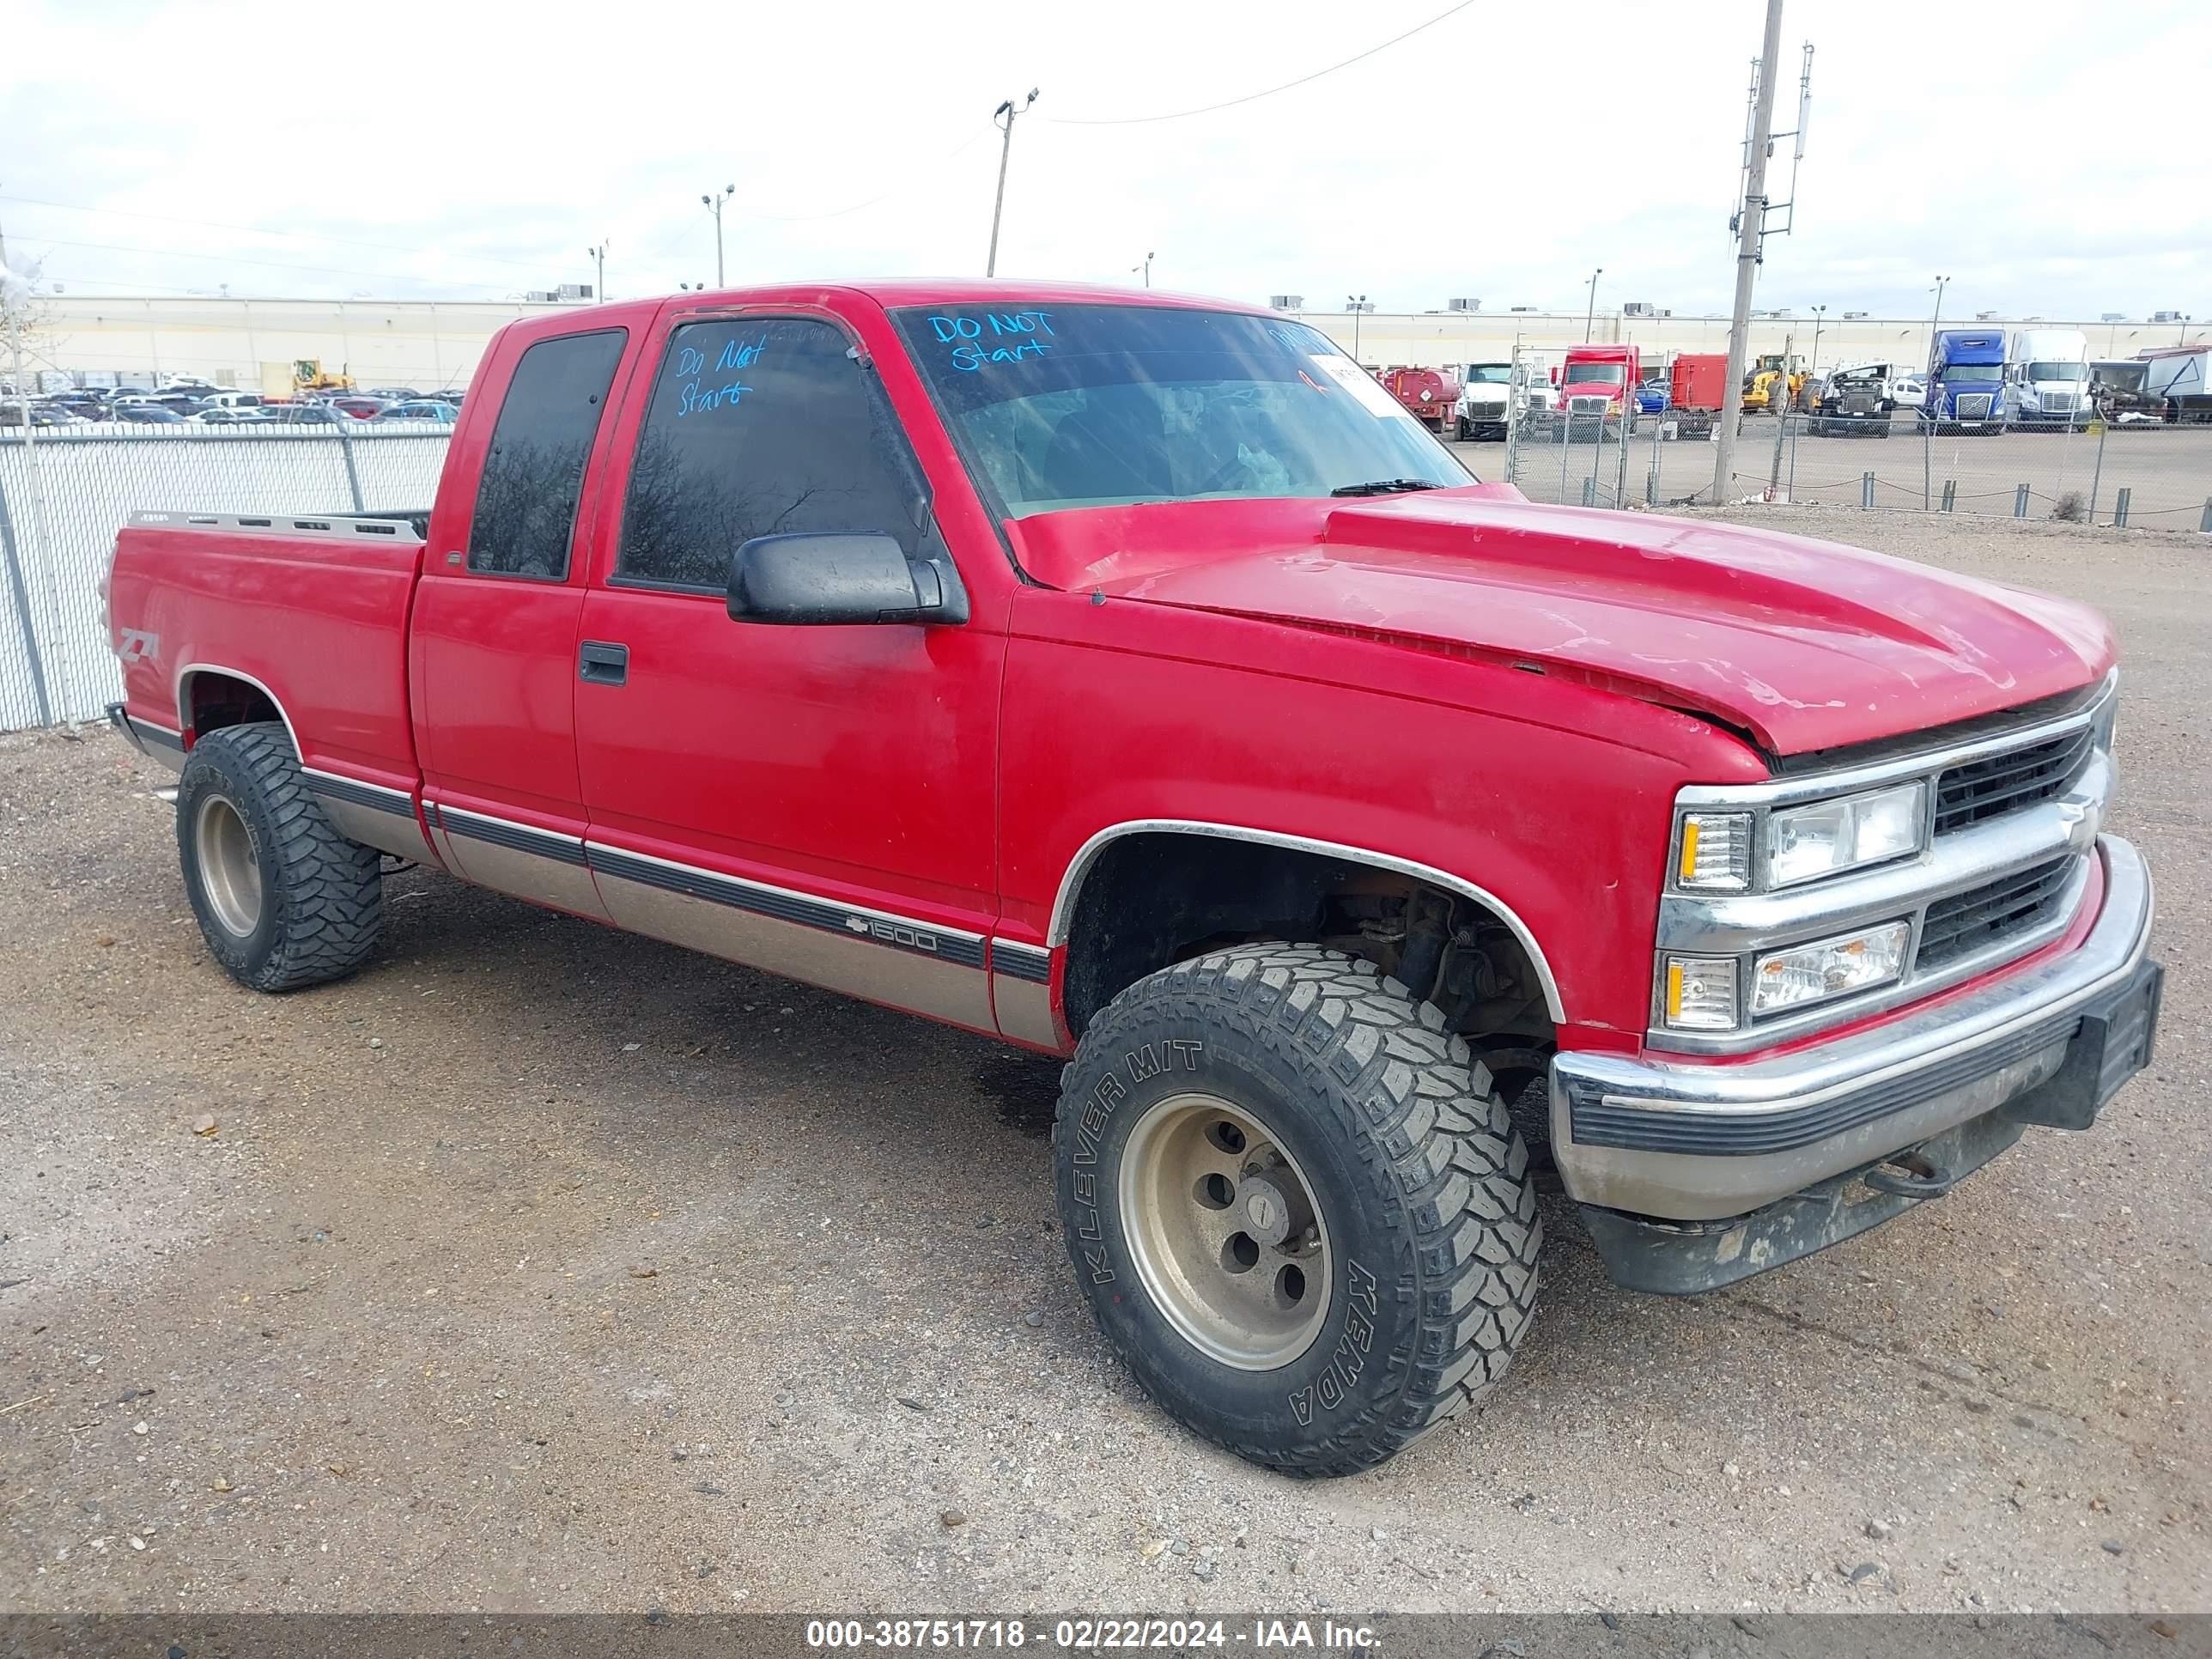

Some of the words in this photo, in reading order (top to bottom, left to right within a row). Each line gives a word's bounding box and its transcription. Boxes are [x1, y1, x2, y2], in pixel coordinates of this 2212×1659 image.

[927, 316, 981, 343] DO
[988, 312, 1055, 337] NOT
[676, 347, 705, 378] Do
[951, 338, 1052, 372] Start
[677, 377, 754, 416] Start
[869, 921, 937, 951] 1500
[1073, 1073, 1126, 1284] KLEVER
[1126, 1040, 1202, 1083] M/T
[1289, 1259, 1377, 1426] KENDA
